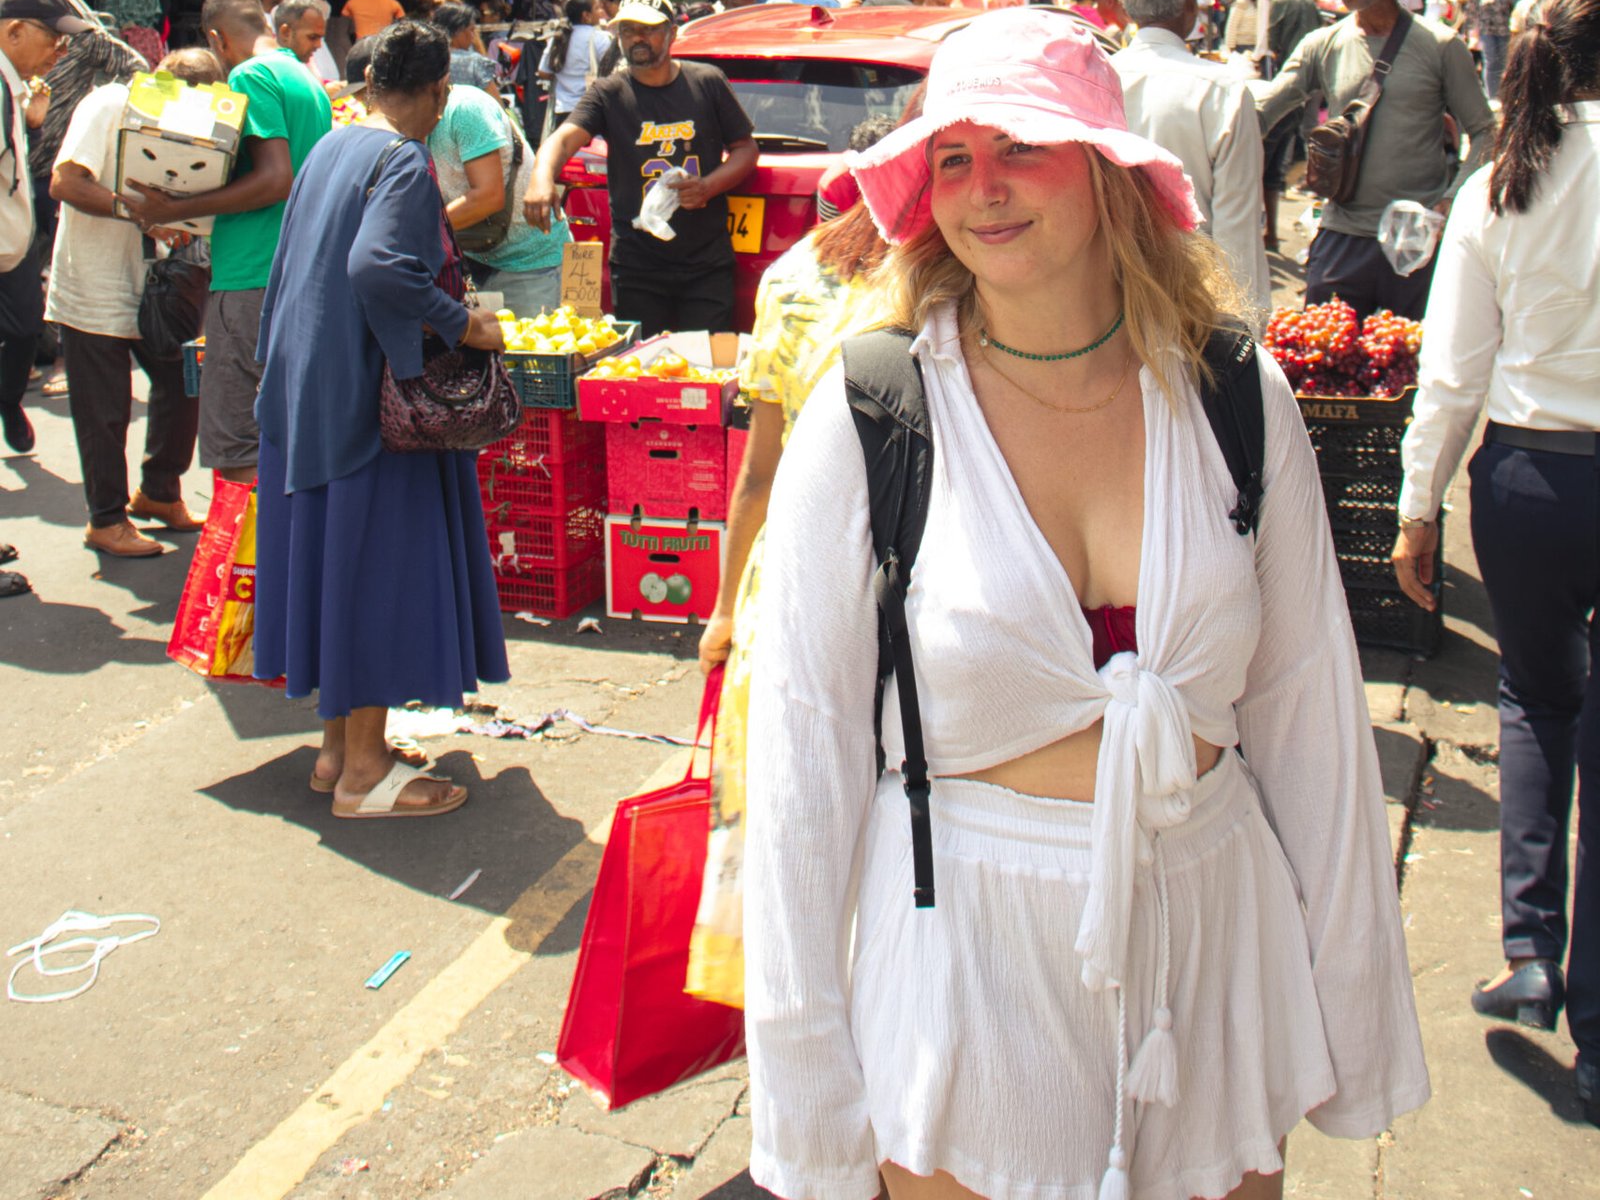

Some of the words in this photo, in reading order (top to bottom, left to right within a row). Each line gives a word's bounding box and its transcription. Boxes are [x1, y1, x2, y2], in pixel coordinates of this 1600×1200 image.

[635, 120, 696, 146] LAKERS
[1302, 403, 1360, 420] MAFA
[619, 530, 659, 551] TUTTI
[662, 535, 711, 552] FRUTTI
